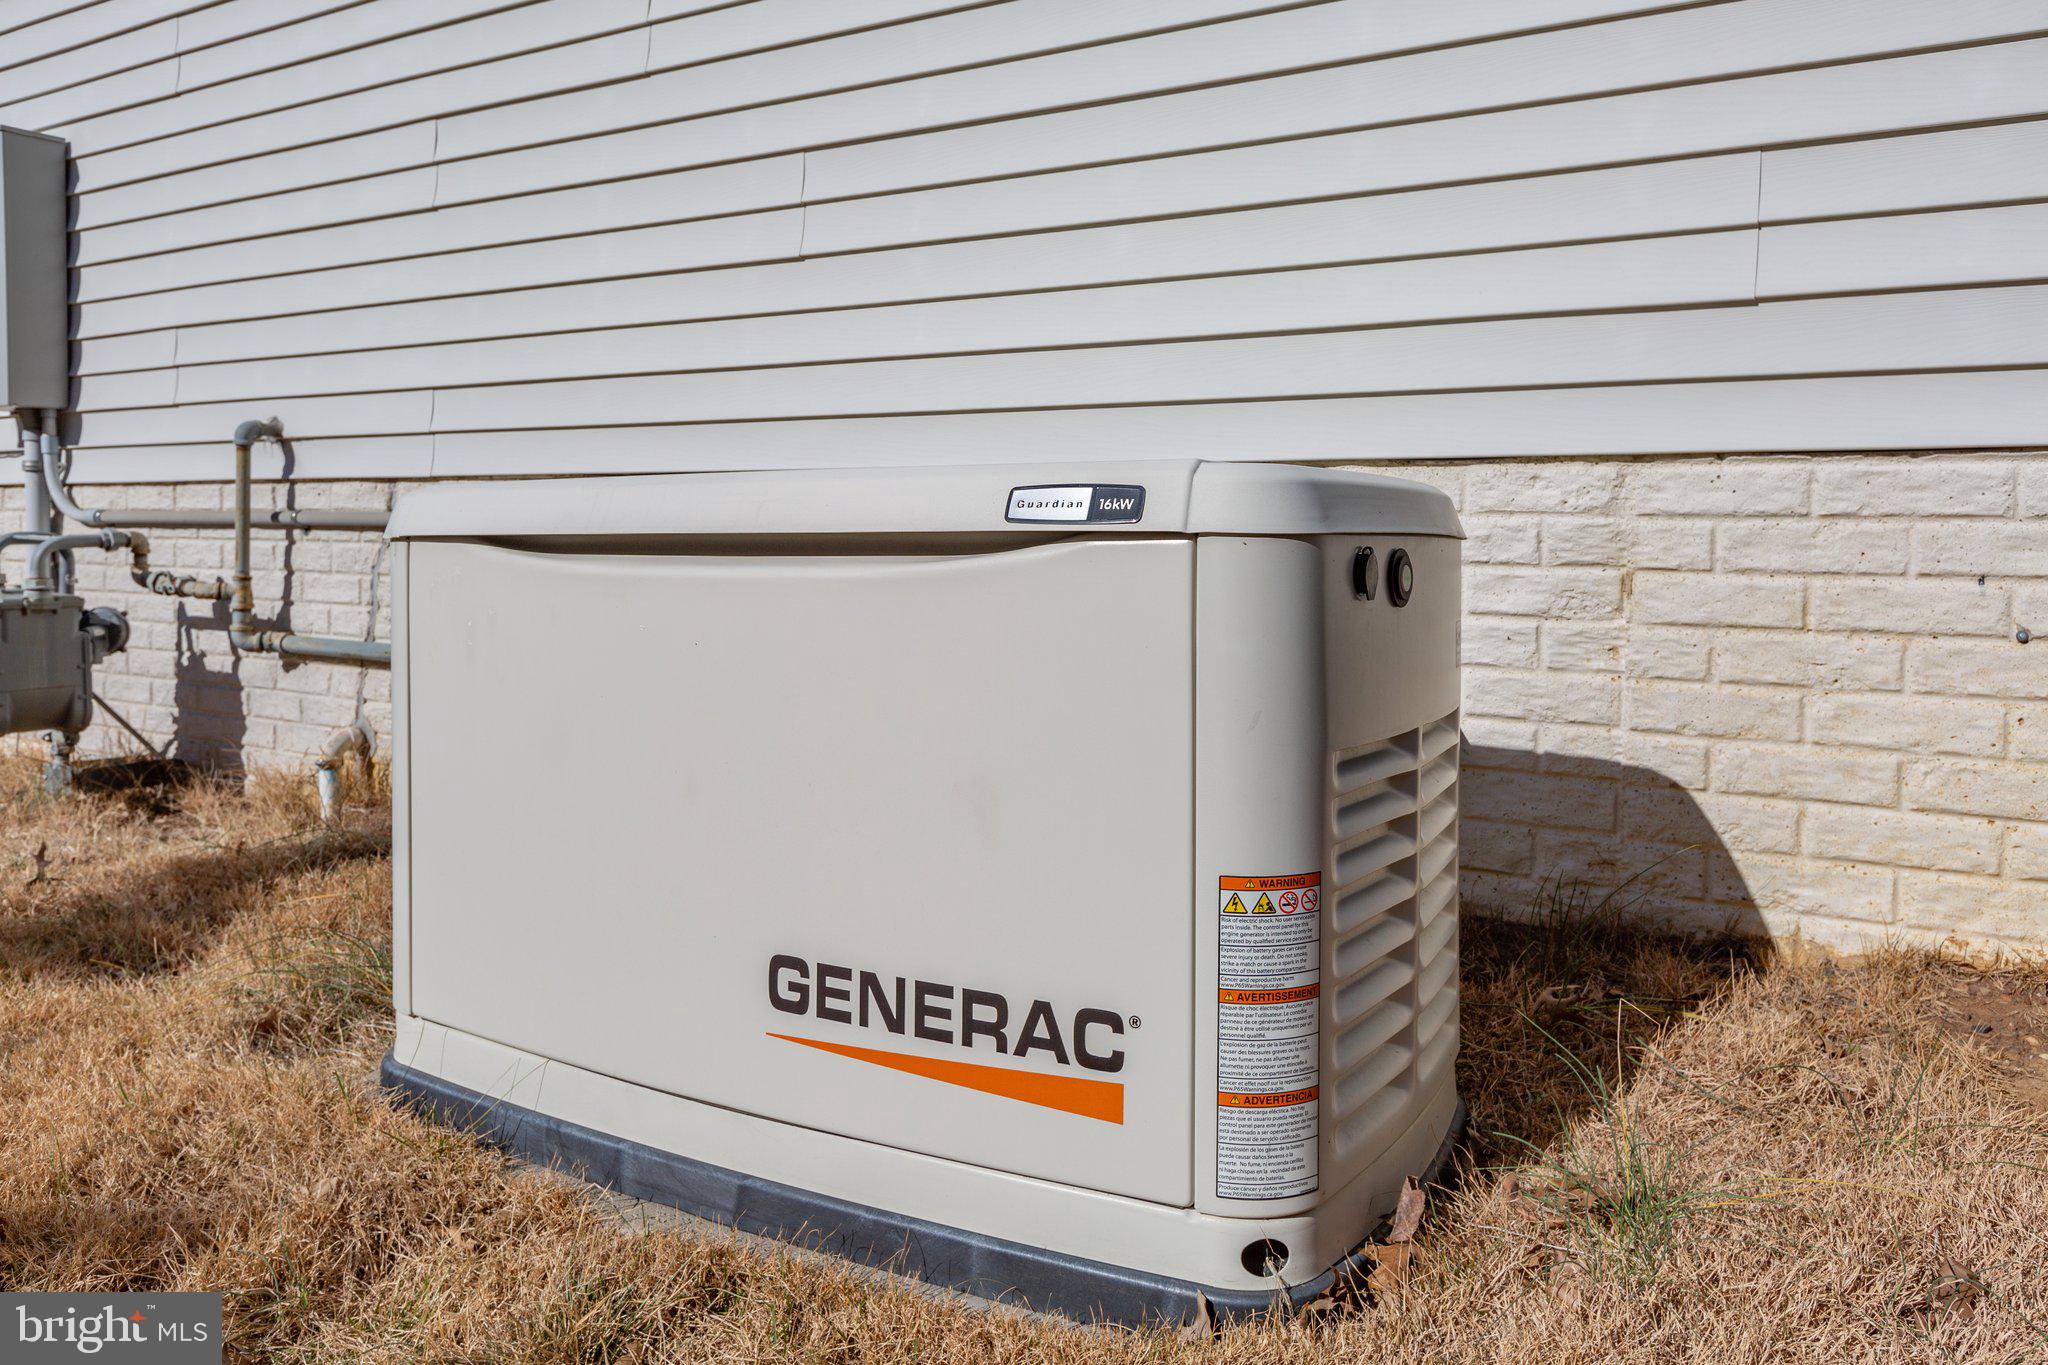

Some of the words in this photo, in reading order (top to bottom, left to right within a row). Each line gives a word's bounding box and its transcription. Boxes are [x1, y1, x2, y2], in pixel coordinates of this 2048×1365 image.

[1017, 499, 1083, 509] Guardian
[1099, 498, 1135, 510] 16kW
[1259, 878, 1305, 888] WARNING
[1237, 987, 1317, 1001] AVERTISSEMENT
[1244, 1092, 1312, 1104] ADVERTENCIA
